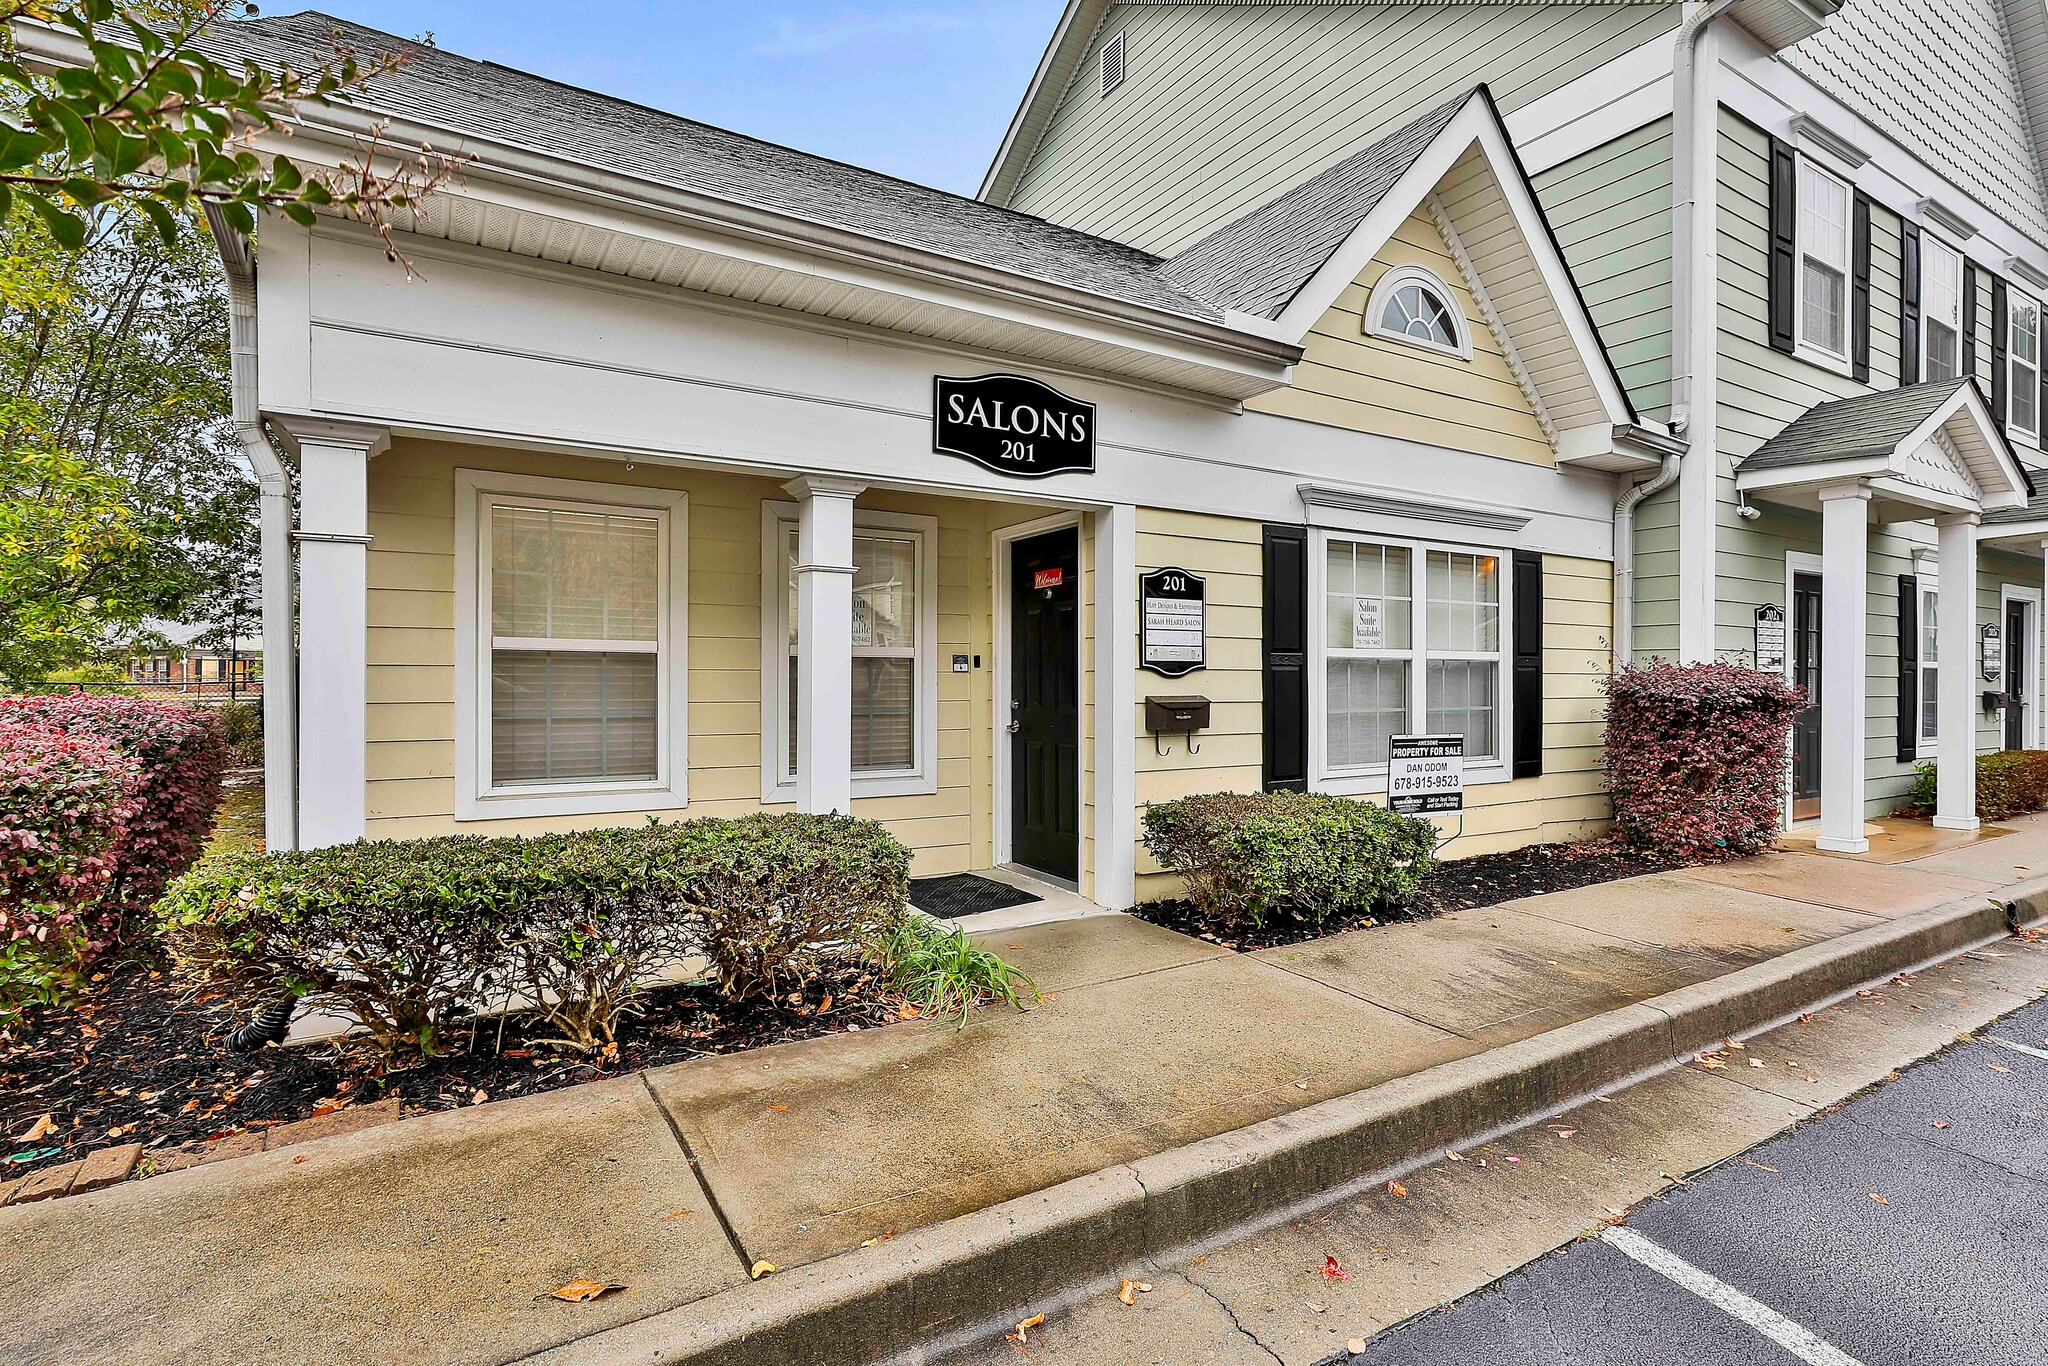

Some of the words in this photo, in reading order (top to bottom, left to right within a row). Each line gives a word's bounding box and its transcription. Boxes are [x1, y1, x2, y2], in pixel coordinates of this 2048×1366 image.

[947, 393, 1086, 442] SALONS
[1000, 440, 1036, 462] 201
[1162, 576, 1186, 591] 201
[1157, 601, 1173, 611] Designs
[1358, 600, 1377, 613] Salon
[1147, 617, 1164, 625] SARAH
[1165, 617, 1184, 626] HEARD
[1184, 618, 1201, 626] SALON
[1359, 613, 1377, 626] Suite
[1356, 626, 1381, 637] Available
[1392, 747, 1429, 758] PROPERTY
[1429, 747, 1444, 756] FOR
[1444, 746, 1462, 755] SALE
[1406, 763, 1423, 773] DAN
[1424, 762, 1448, 772] ODOM
[1394, 775, 1459, 790] 678-915-9523
